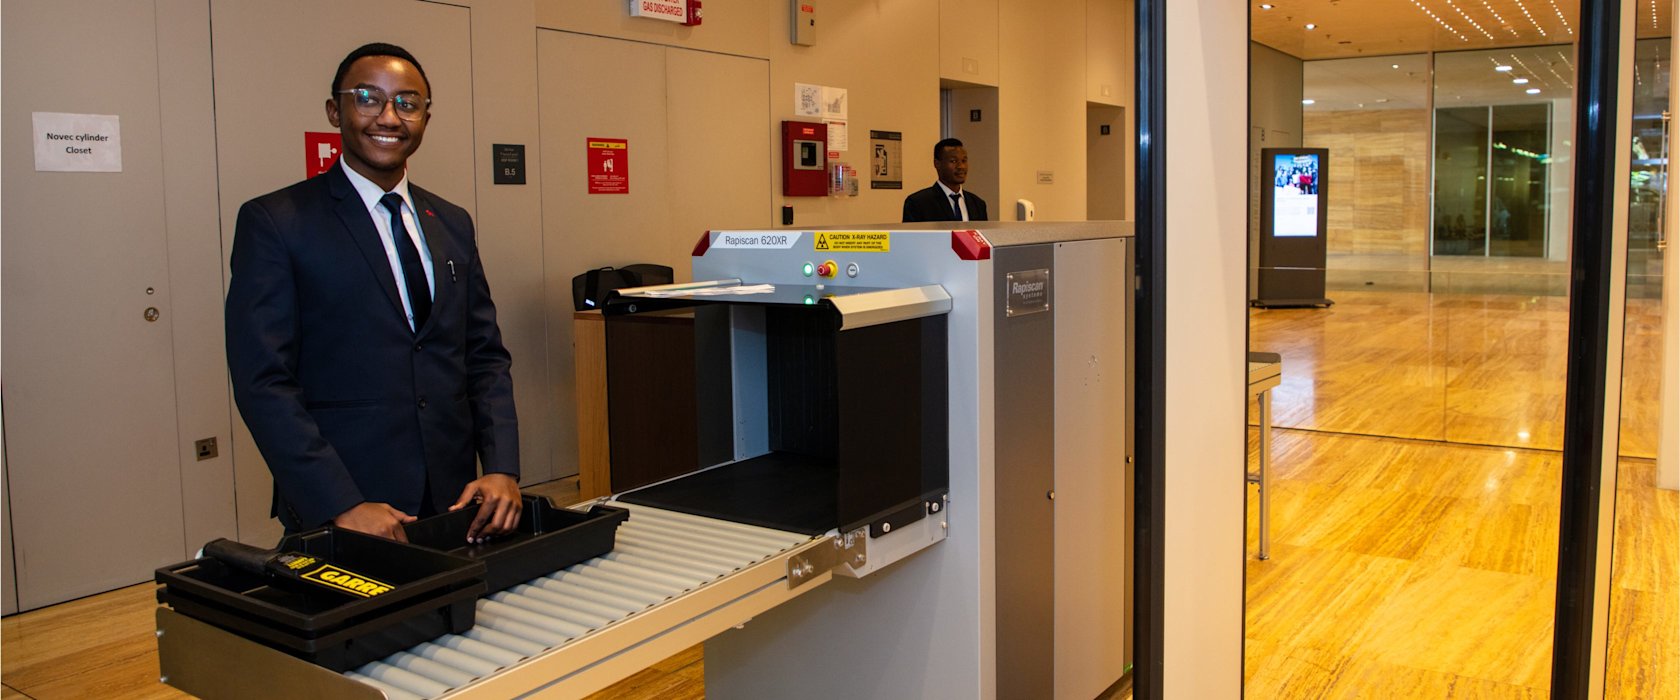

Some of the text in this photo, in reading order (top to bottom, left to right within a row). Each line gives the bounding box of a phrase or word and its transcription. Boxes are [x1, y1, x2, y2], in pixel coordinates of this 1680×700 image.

[643, 1, 682, 16] GAS DISCHARGED
[75, 133, 109, 142] cylinder
[65, 146, 92, 154] Closet
[725, 235, 788, 246] Rapiscan 620XR
[1012, 281, 1043, 295] Rapiscan
